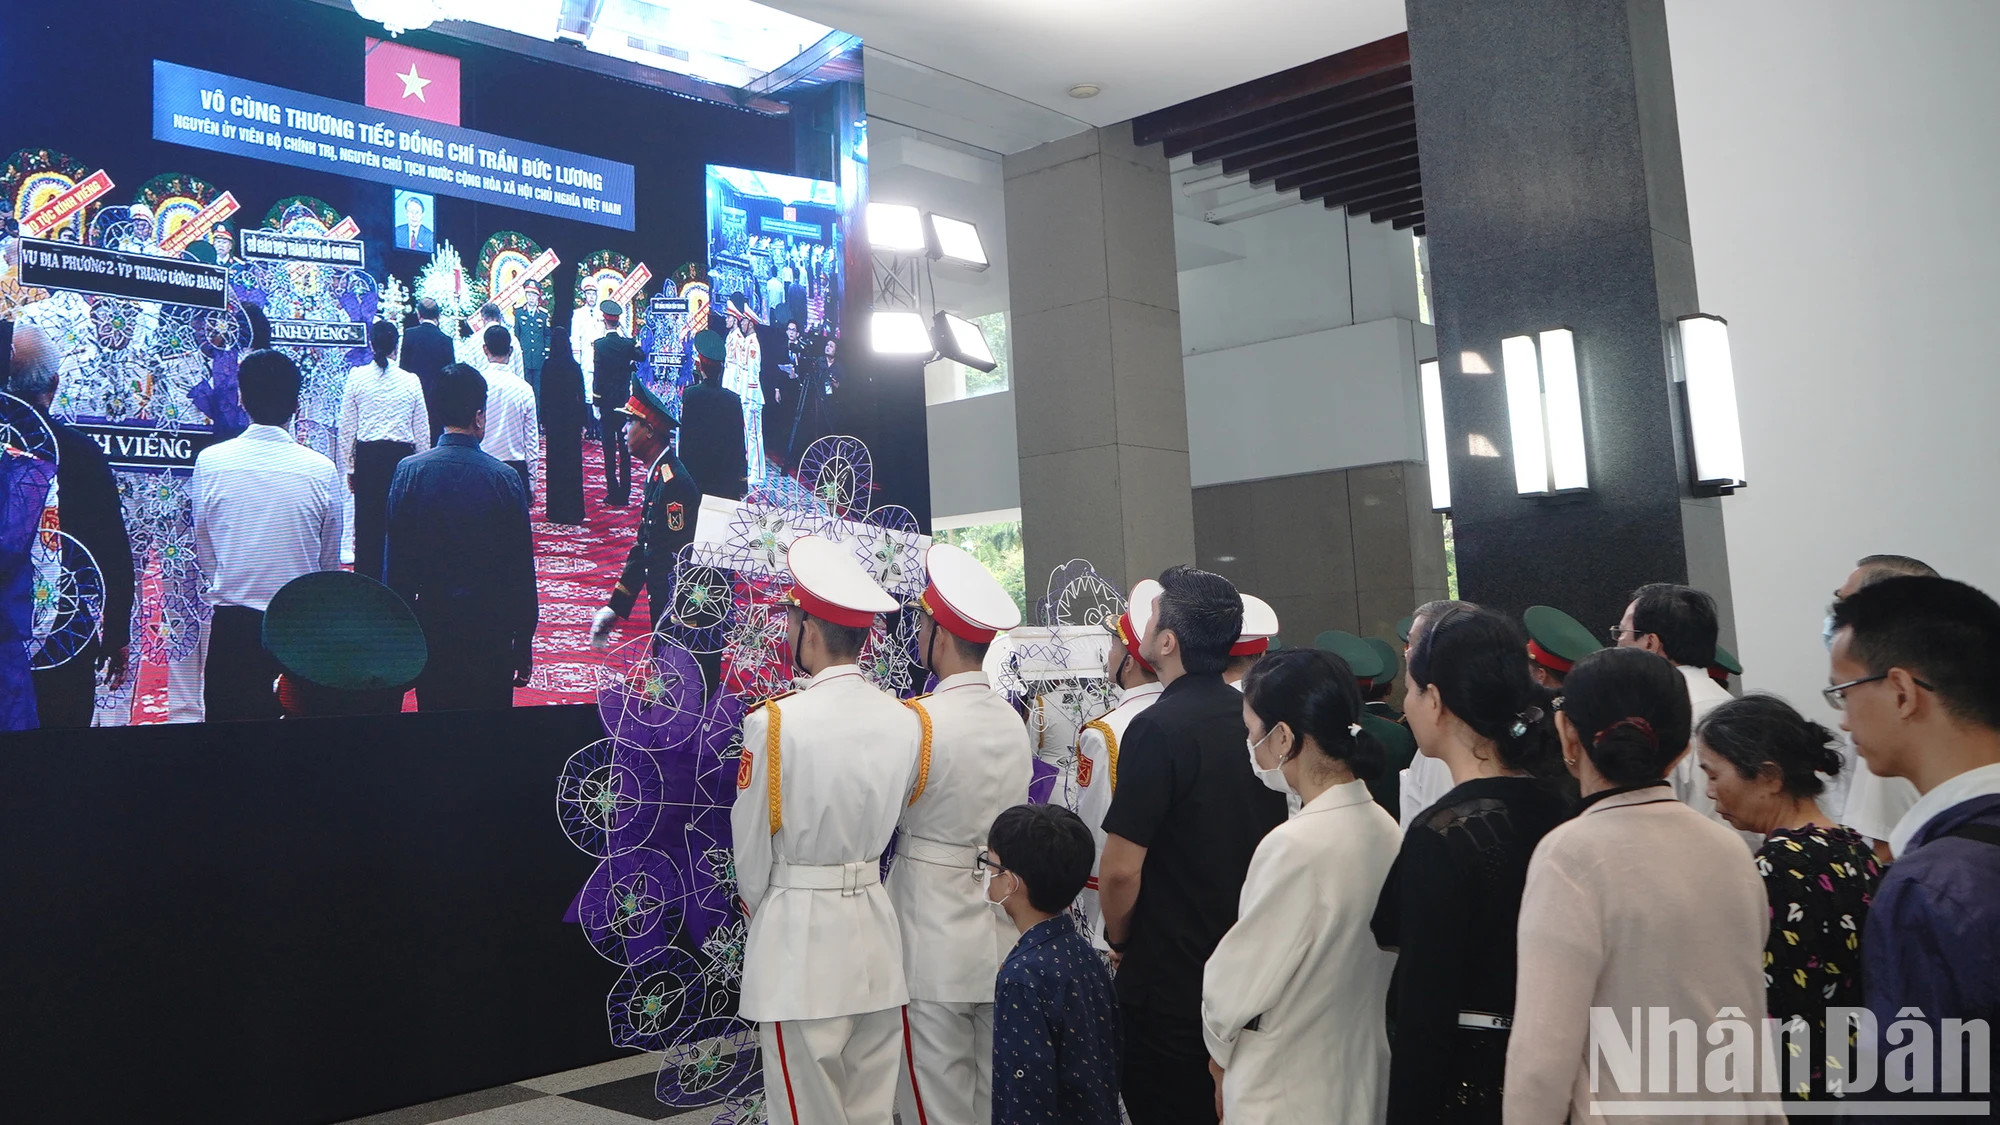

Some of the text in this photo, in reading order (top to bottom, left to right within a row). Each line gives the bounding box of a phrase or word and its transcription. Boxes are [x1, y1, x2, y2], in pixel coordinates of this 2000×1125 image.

[200, 88, 603, 192] VÔ CÙNG THƯƠNG TIẾC ĐỒNG CHÍ TRẦN ĐỨC LƯƠNG
[173, 113, 622, 216] NGUYÊN ỦY VIÊN BỘ CHÍNH TRỊ, NGUYÊN CHỦ TỊCH NƯỚC CỘNG HÒA XÃ HỘI CHỦ NGHĨA VIỆT NAM
[36, 208, 57, 227] TỘC
[52, 194, 78, 216] KÍNH
[74, 180, 102, 202] VIẾNG
[22, 248, 38, 269] VỤ
[40, 252, 60, 271] ĐỊA
[62, 254, 107, 274] PHƯƠNG
[134, 264, 168, 282] TRUNG
[168, 269, 196, 288] ƯƠNG
[196, 271, 224, 292] ĐẢNG
[115, 431, 192, 460] VIẾNG
